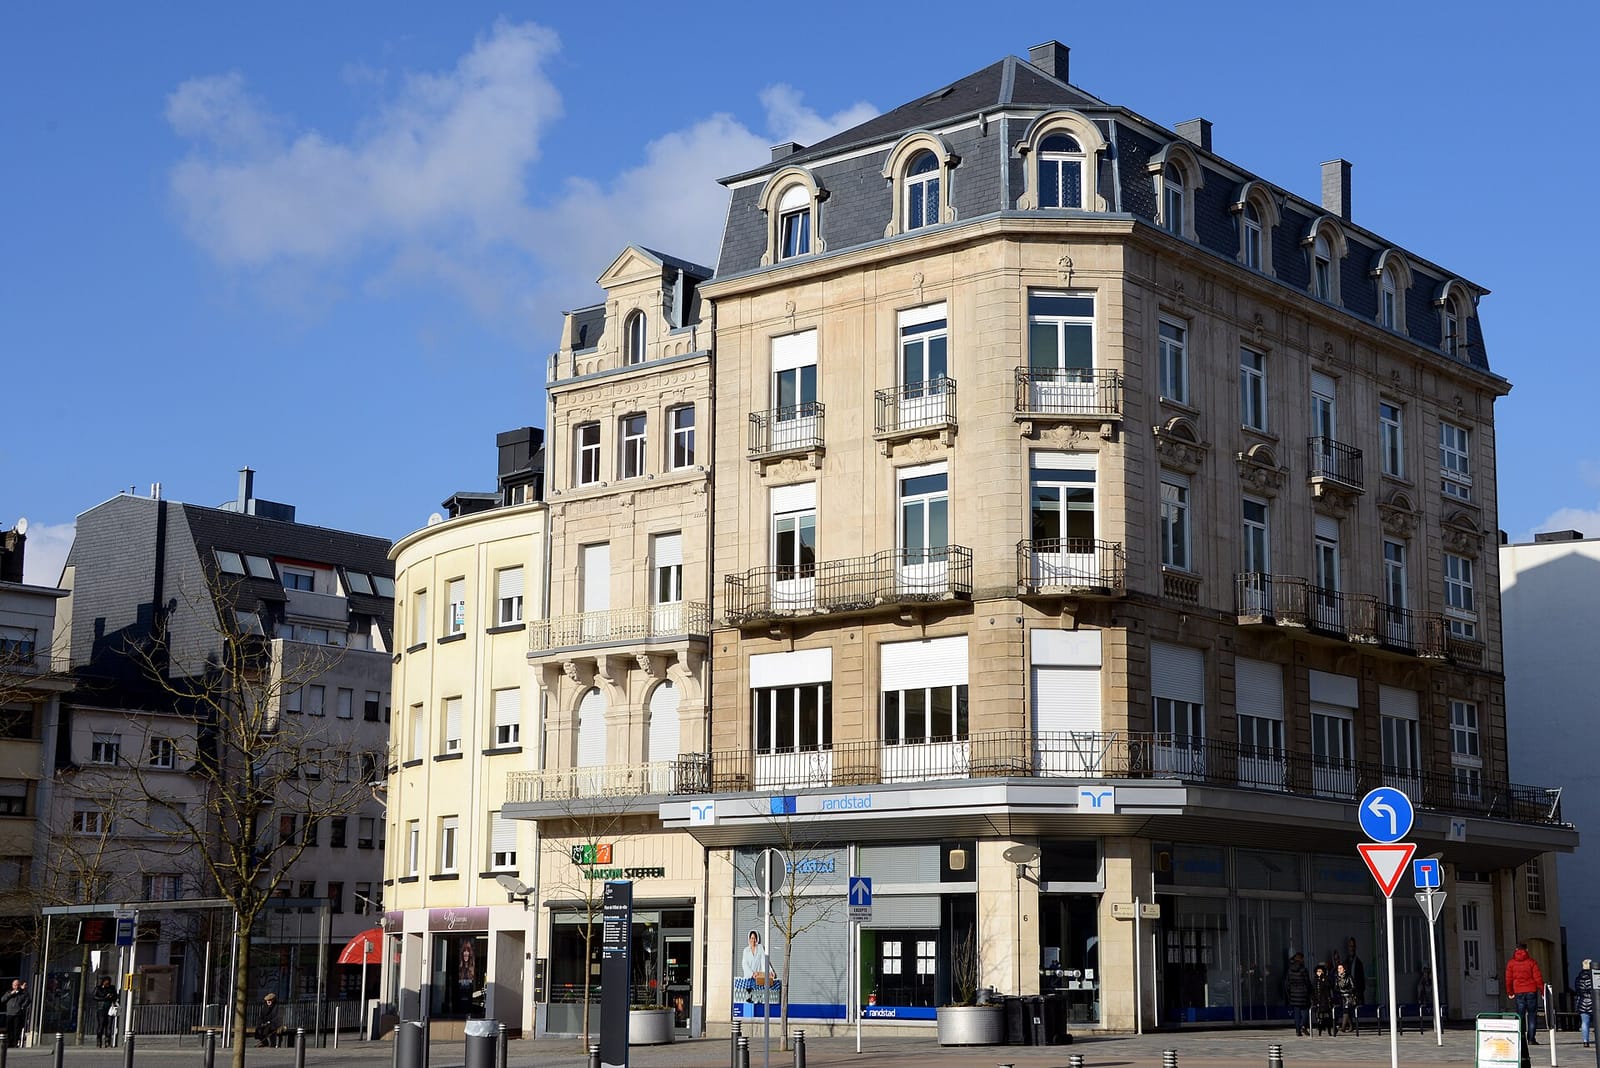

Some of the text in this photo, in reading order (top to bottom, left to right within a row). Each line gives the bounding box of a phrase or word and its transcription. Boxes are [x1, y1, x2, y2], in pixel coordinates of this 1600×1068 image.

[822, 794, 872, 810] randstad
[785, 856, 834, 873] andstad
[584, 868, 622, 880] MAISON
[1023, 914, 1029, 922] 6
[868, 1008, 896, 1017] randstad
